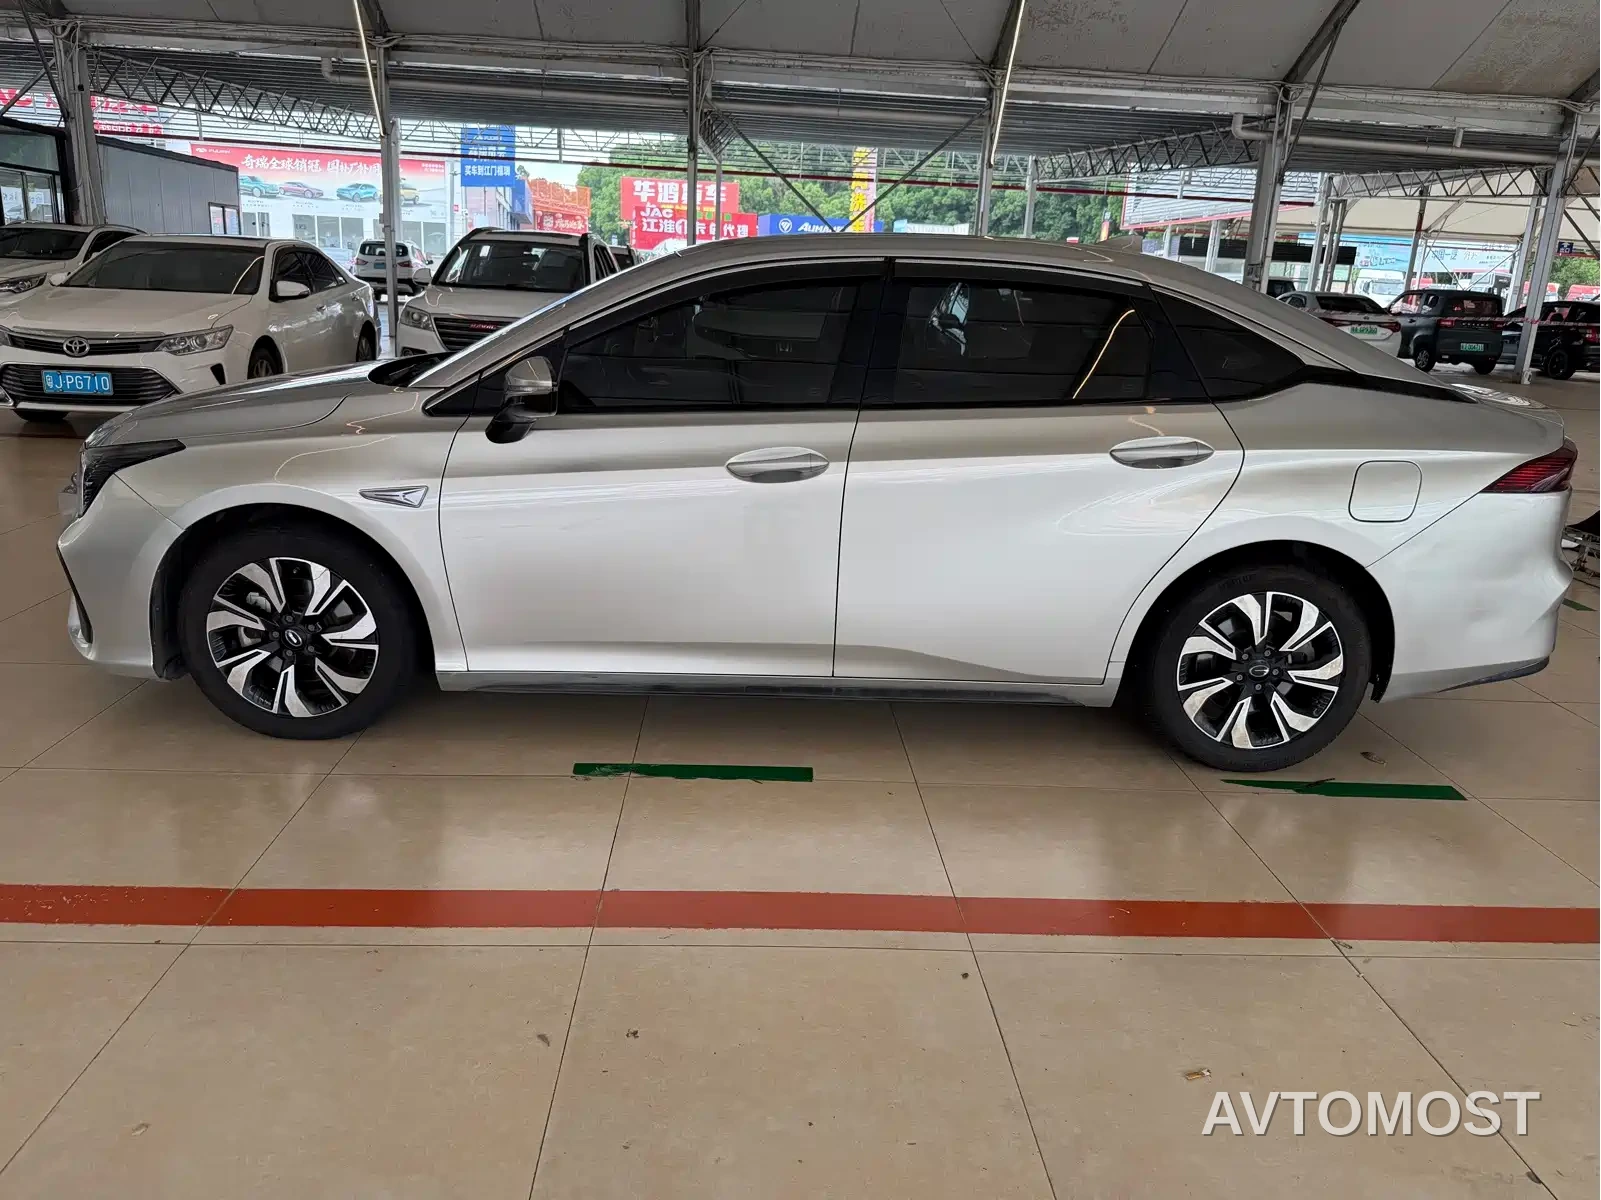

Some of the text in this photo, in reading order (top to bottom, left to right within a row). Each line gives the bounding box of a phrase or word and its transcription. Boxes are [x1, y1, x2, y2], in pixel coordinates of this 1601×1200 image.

[241, 154, 321, 173] 奇瑞全球销冠
[640, 206, 674, 219] JAC
